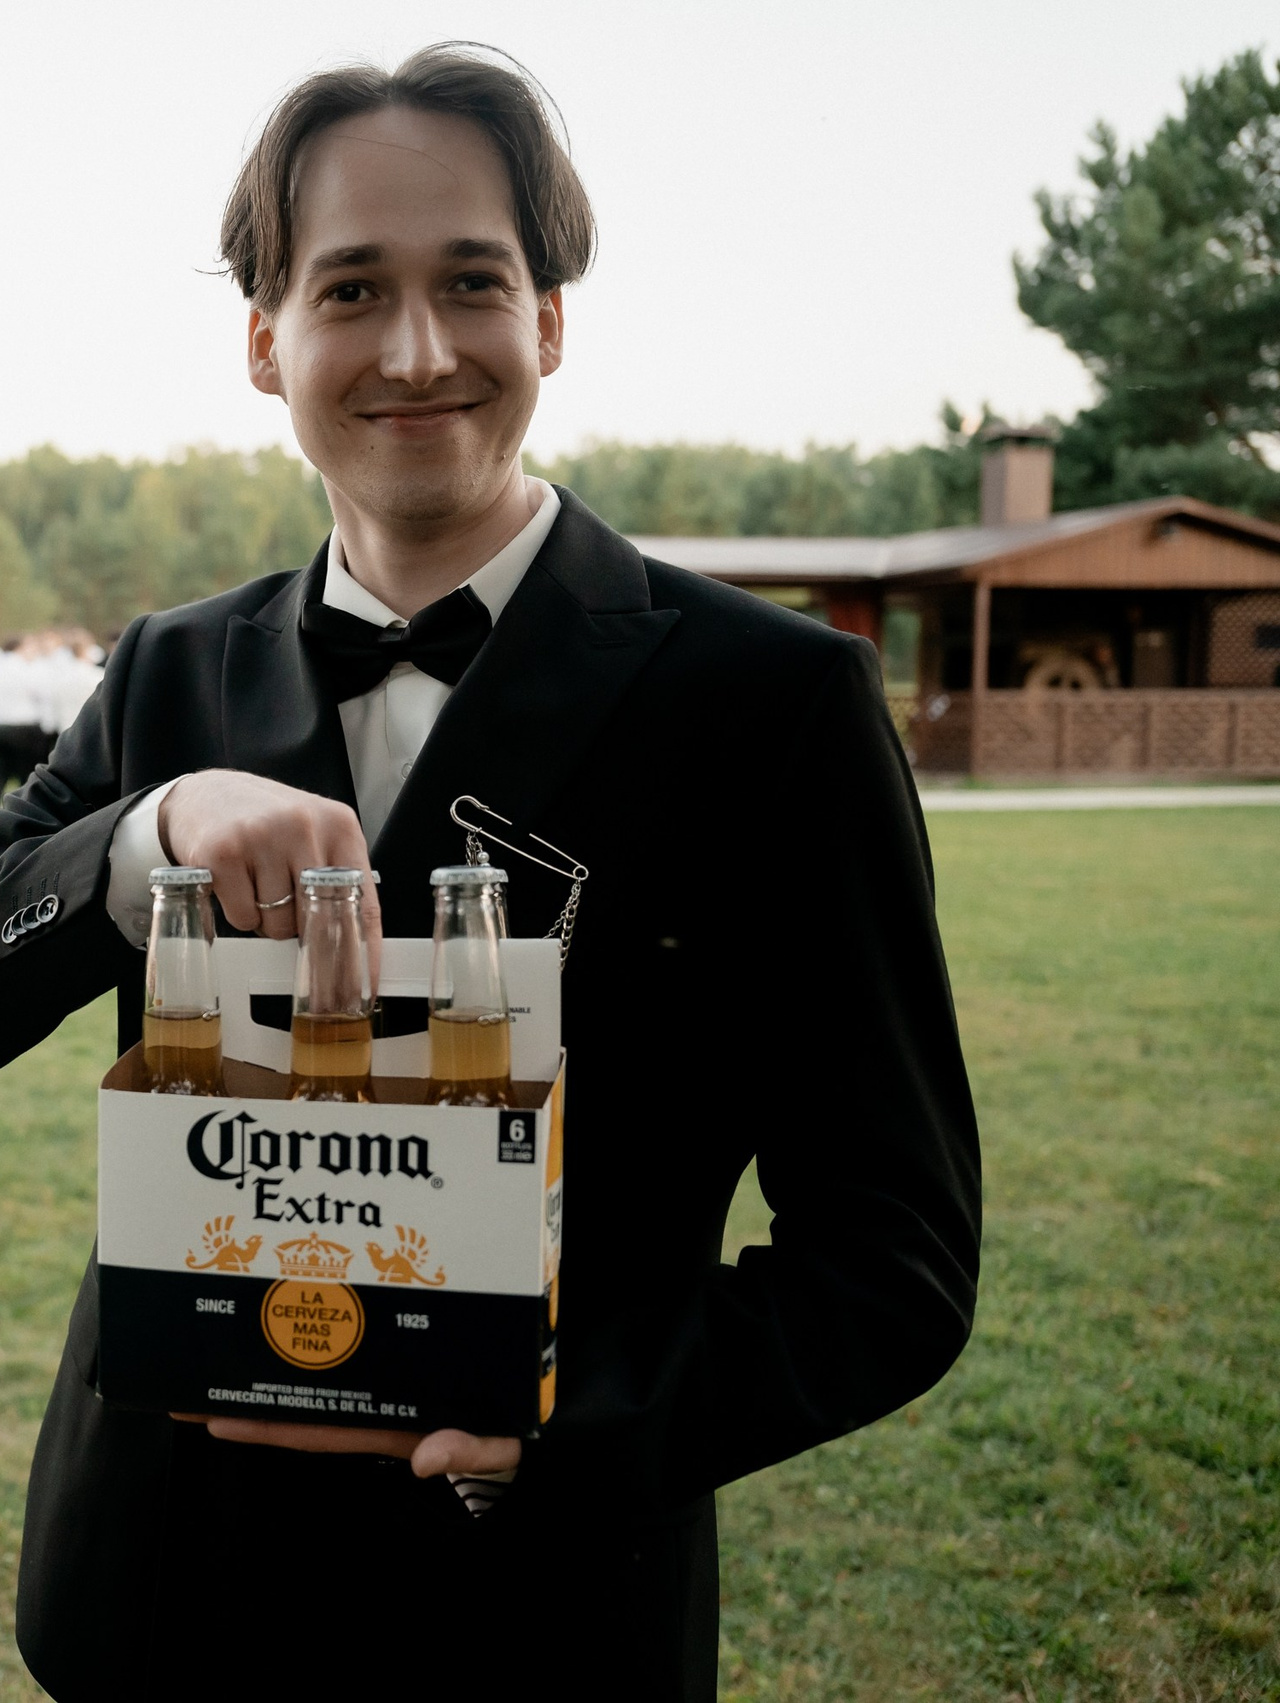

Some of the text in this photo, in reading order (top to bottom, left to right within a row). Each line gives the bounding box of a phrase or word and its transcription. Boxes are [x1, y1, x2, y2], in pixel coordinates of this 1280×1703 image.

[509, 1119, 526, 1142] 6
[252, 1177, 382, 1228] Extra
[195, 1297, 236, 1315] SINCE
[301, 1290, 324, 1305] LA
[272, 1304, 353, 1323] CERVEZA
[394, 1312, 430, 1330] 1925
[293, 1321, 331, 1338] MAS
[291, 1336, 332, 1352] FINA
[293, 1385, 315, 1397] BEER
[207, 1387, 276, 1406] CERVECERIA
[340, 1399, 356, 1413] DE
[380, 1402, 397, 1416] DE
